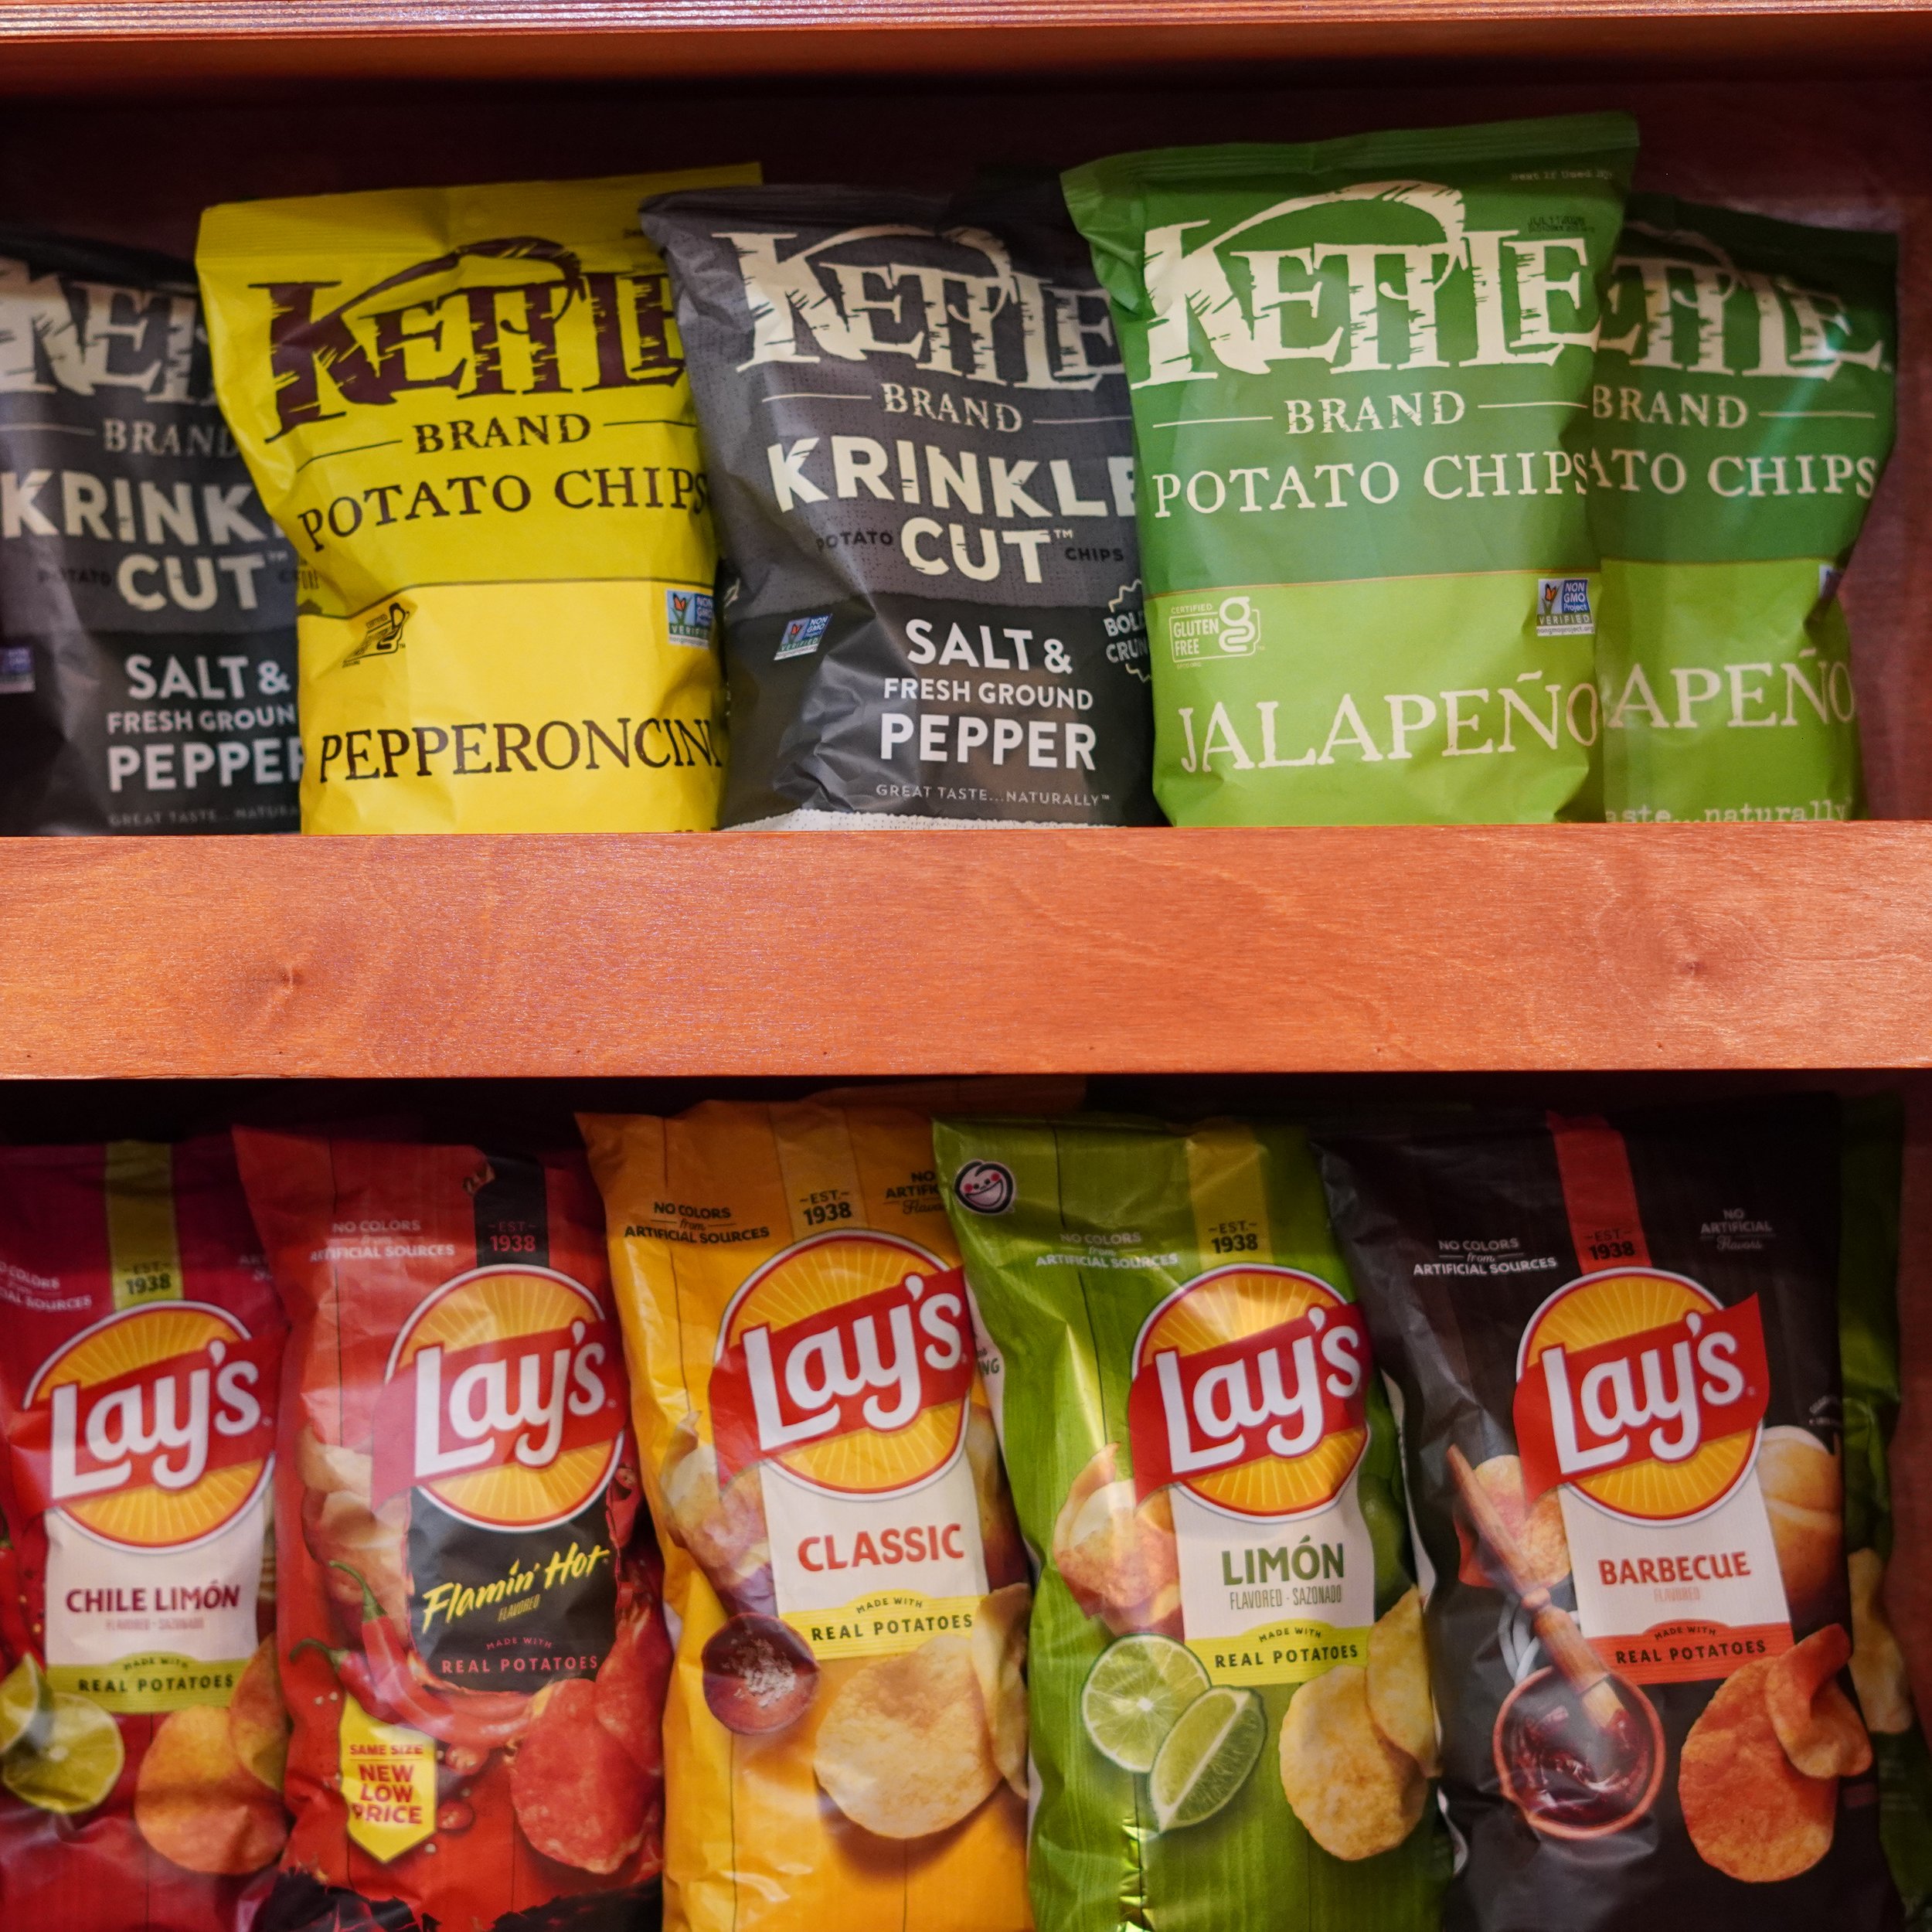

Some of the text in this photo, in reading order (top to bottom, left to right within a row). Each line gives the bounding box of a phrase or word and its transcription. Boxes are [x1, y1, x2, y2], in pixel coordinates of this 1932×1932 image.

[1131, 179, 1600, 391] KETTLE
[711, 224, 1125, 391] KETTLE
[881, 383, 1023, 433] BRAND
[1284, 390, 1465, 434] BRAND
[1593, 385, 1749, 429] BRAND
[413, 413, 592, 454] BRAND
[1151, 450, 1587, 519] POTATO CHIPS
[1707, 454, 1879, 501] CHIPS
[298, 466, 707, 552] POTATO CHIPS
[815, 529, 894, 550] POTATO
[1065, 546, 1124, 563] CHIPS
[1565, 582, 1585, 593] NON
[1171, 603, 1213, 615] CERTIFIED
[1563, 593, 1586, 604] GMO
[1563, 603, 1587, 612] Project
[1173, 617, 1219, 638] GLUTEN
[1539, 614, 1590, 626] VERIFIED
[906, 619, 1074, 675] SALT &
[1175, 638, 1200, 656] FREE
[125, 654, 291, 700] SALT &
[883, 677, 1094, 710] FRESH GROUND
[107, 710, 193, 734] FRESH
[1178, 671, 1598, 773] JALAPEÑO
[320, 716, 723, 784] PEPPERONCINI
[880, 713, 1097, 771] PEPPER
[876, 784, 930, 799] GREAT
[654, 1202, 731, 1219] NO COLORS
[803, 1202, 852, 1226] 1938
[1723, 1208, 1745, 1219] NO
[333, 1219, 421, 1233] NO COLORS
[624, 1226, 770, 1243] ARTIFICIAL SOURCES
[680, 1218, 706, 1231] from
[1700, 1220, 1773, 1234] ARTIFICIAL
[489, 1235, 536, 1253] 1938
[1061, 1233, 1141, 1245] NO COLORS
[1211, 1233, 1259, 1253] 1938
[1438, 1238, 1519, 1251] NO COLORS
[384, 1244, 455, 1258] SOURCES
[1467, 1252, 1496, 1262] from
[1589, 1240, 1636, 1260] 1938
[1036, 1253, 1178, 1269] ARTIFICIAL SOURCES
[1413, 1257, 1557, 1276] ARTIFICIAL SOURCES
[126, 1273, 172, 1294] 1938
[26, 1294, 92, 1311] SOURCES
[742, 1274, 963, 1451] Lay's
[415, 1321, 606, 1478] Lay's
[1155, 1306, 1362, 1475] Lay's
[1541, 1311, 1745, 1475] Lay's
[52, 1340, 263, 1499] Lay's
[797, 1522, 964, 1572] CLASSIC
[544, 1542, 611, 1590] Hot
[1221, 1535, 1345, 1586] LIMÓN
[1598, 1551, 1751, 1585] BARBECUE
[66, 1580, 241, 1613] CHILE LIMÓN
[855, 1597, 923, 1614] MADE WITH
[1230, 1585, 1342, 1611] FLAVORED SAZONADO
[811, 1614, 974, 1641] REAL POTATOES
[1258, 1627, 1322, 1643] MADE WITH
[1654, 1626, 1716, 1640] MADE WITH
[486, 1637, 553, 1650] MADE WITH
[1615, 1640, 1767, 1664] REAL POTATOES
[441, 1655, 598, 1674] REAL POTATOES
[1215, 1645, 1359, 1668] REAL POTATOES
[79, 1672, 234, 1693] REAL POTATOES
[349, 1743, 423, 1756] SAME SIZE
[359, 1764, 413, 1783] NEW
[359, 1784, 413, 1802] LOW
[352, 1802, 422, 1825] PRICE
